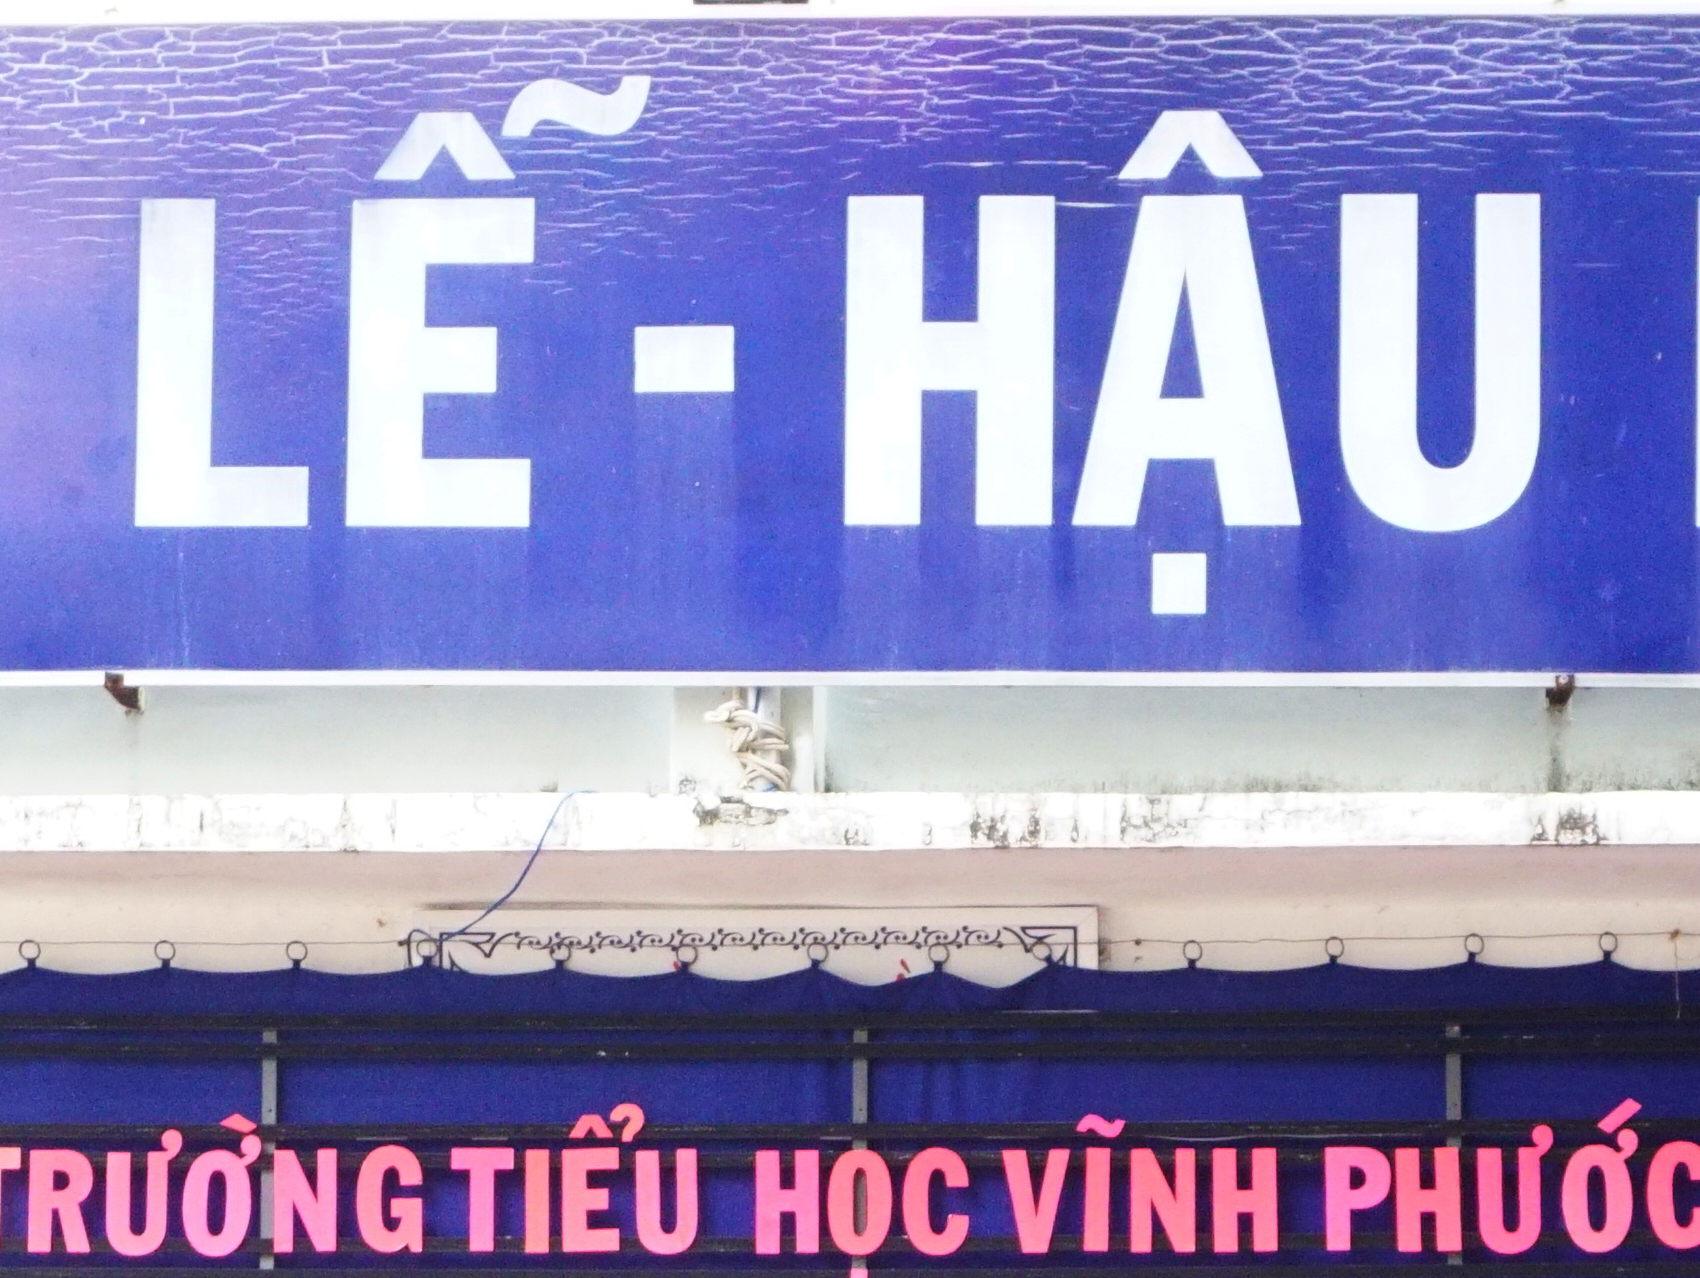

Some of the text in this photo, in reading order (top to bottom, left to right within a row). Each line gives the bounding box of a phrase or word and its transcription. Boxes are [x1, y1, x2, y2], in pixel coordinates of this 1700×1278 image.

[134, 73, 650, 530] LỄ
[634, 325, 735, 392] -
[845, 110, 1543, 613] HẬU
[451, 1103, 699, 1257] TIỂU
[1003, 1116, 1279, 1254] VĨNH
